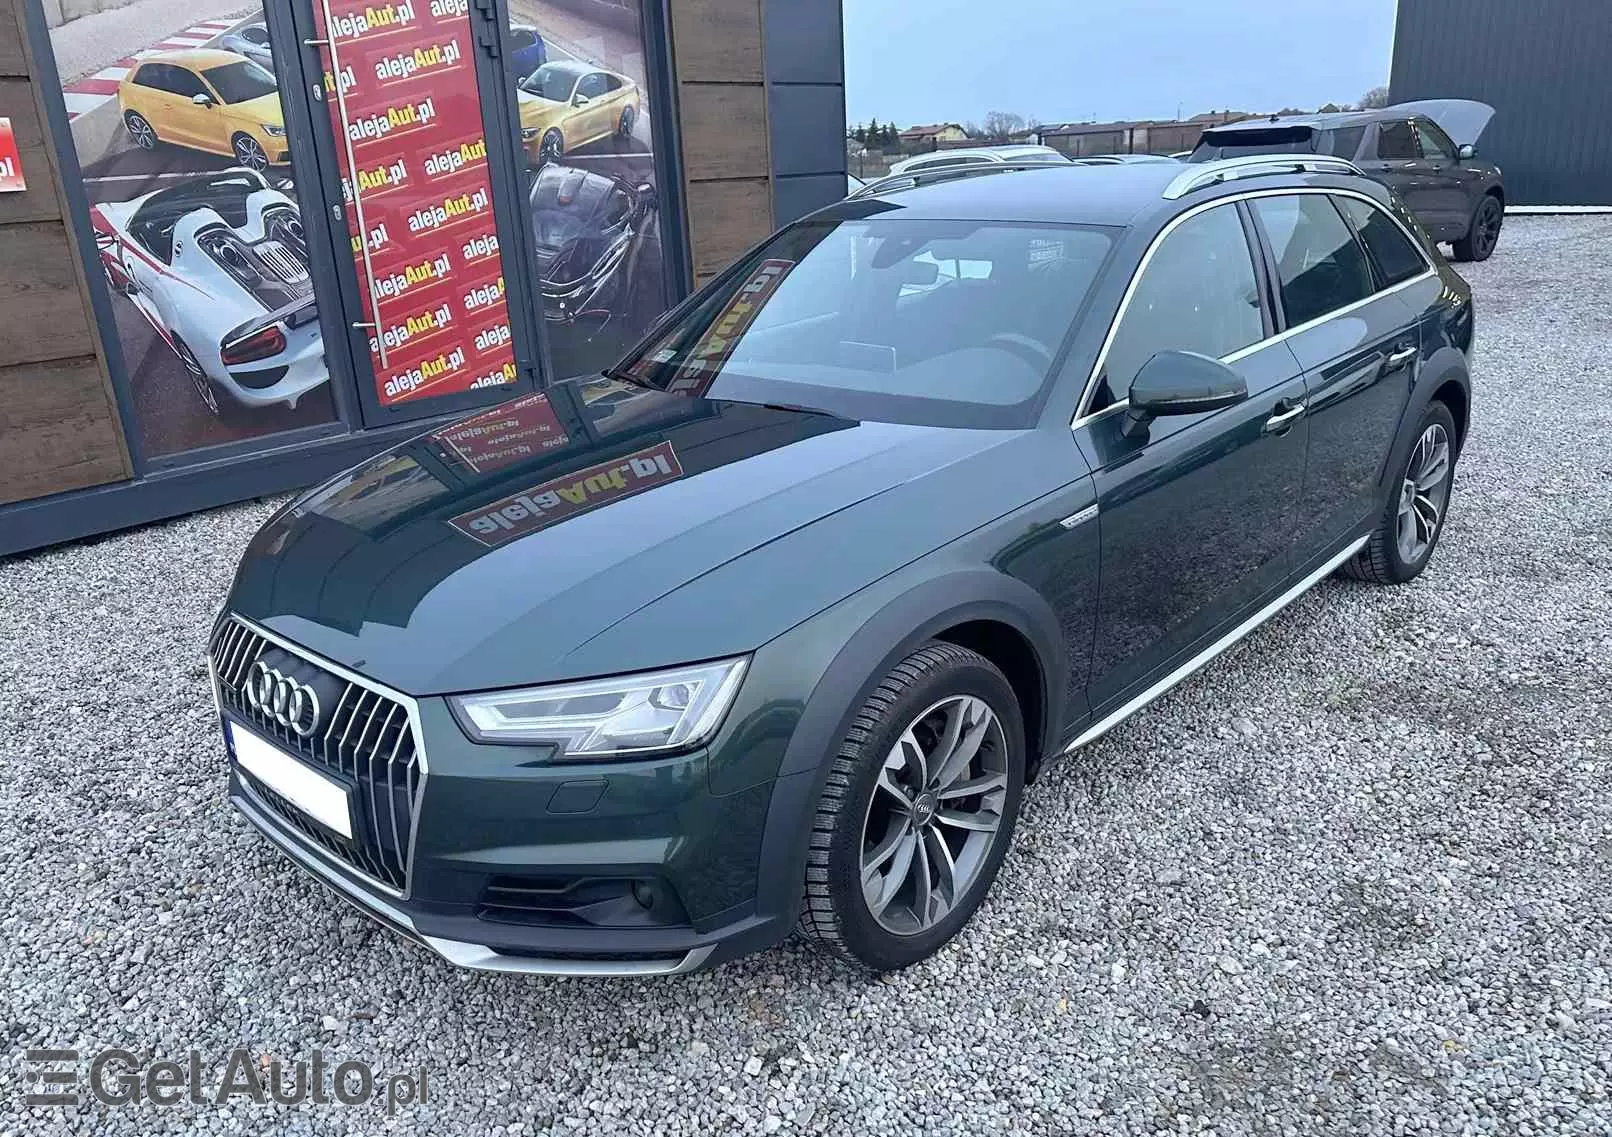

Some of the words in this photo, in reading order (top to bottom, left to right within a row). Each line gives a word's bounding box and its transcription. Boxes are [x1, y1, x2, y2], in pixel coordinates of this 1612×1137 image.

[375, 39, 461, 79] alejaAut.pl
[349, 97, 436, 140] alejaAut.pl
[408, 187, 489, 232] alejaAut.pl
[462, 233, 499, 260] aleja
[368, 303, 452, 353] aejaAut.pl
[384, 346, 465, 397] alejaAut.pl
